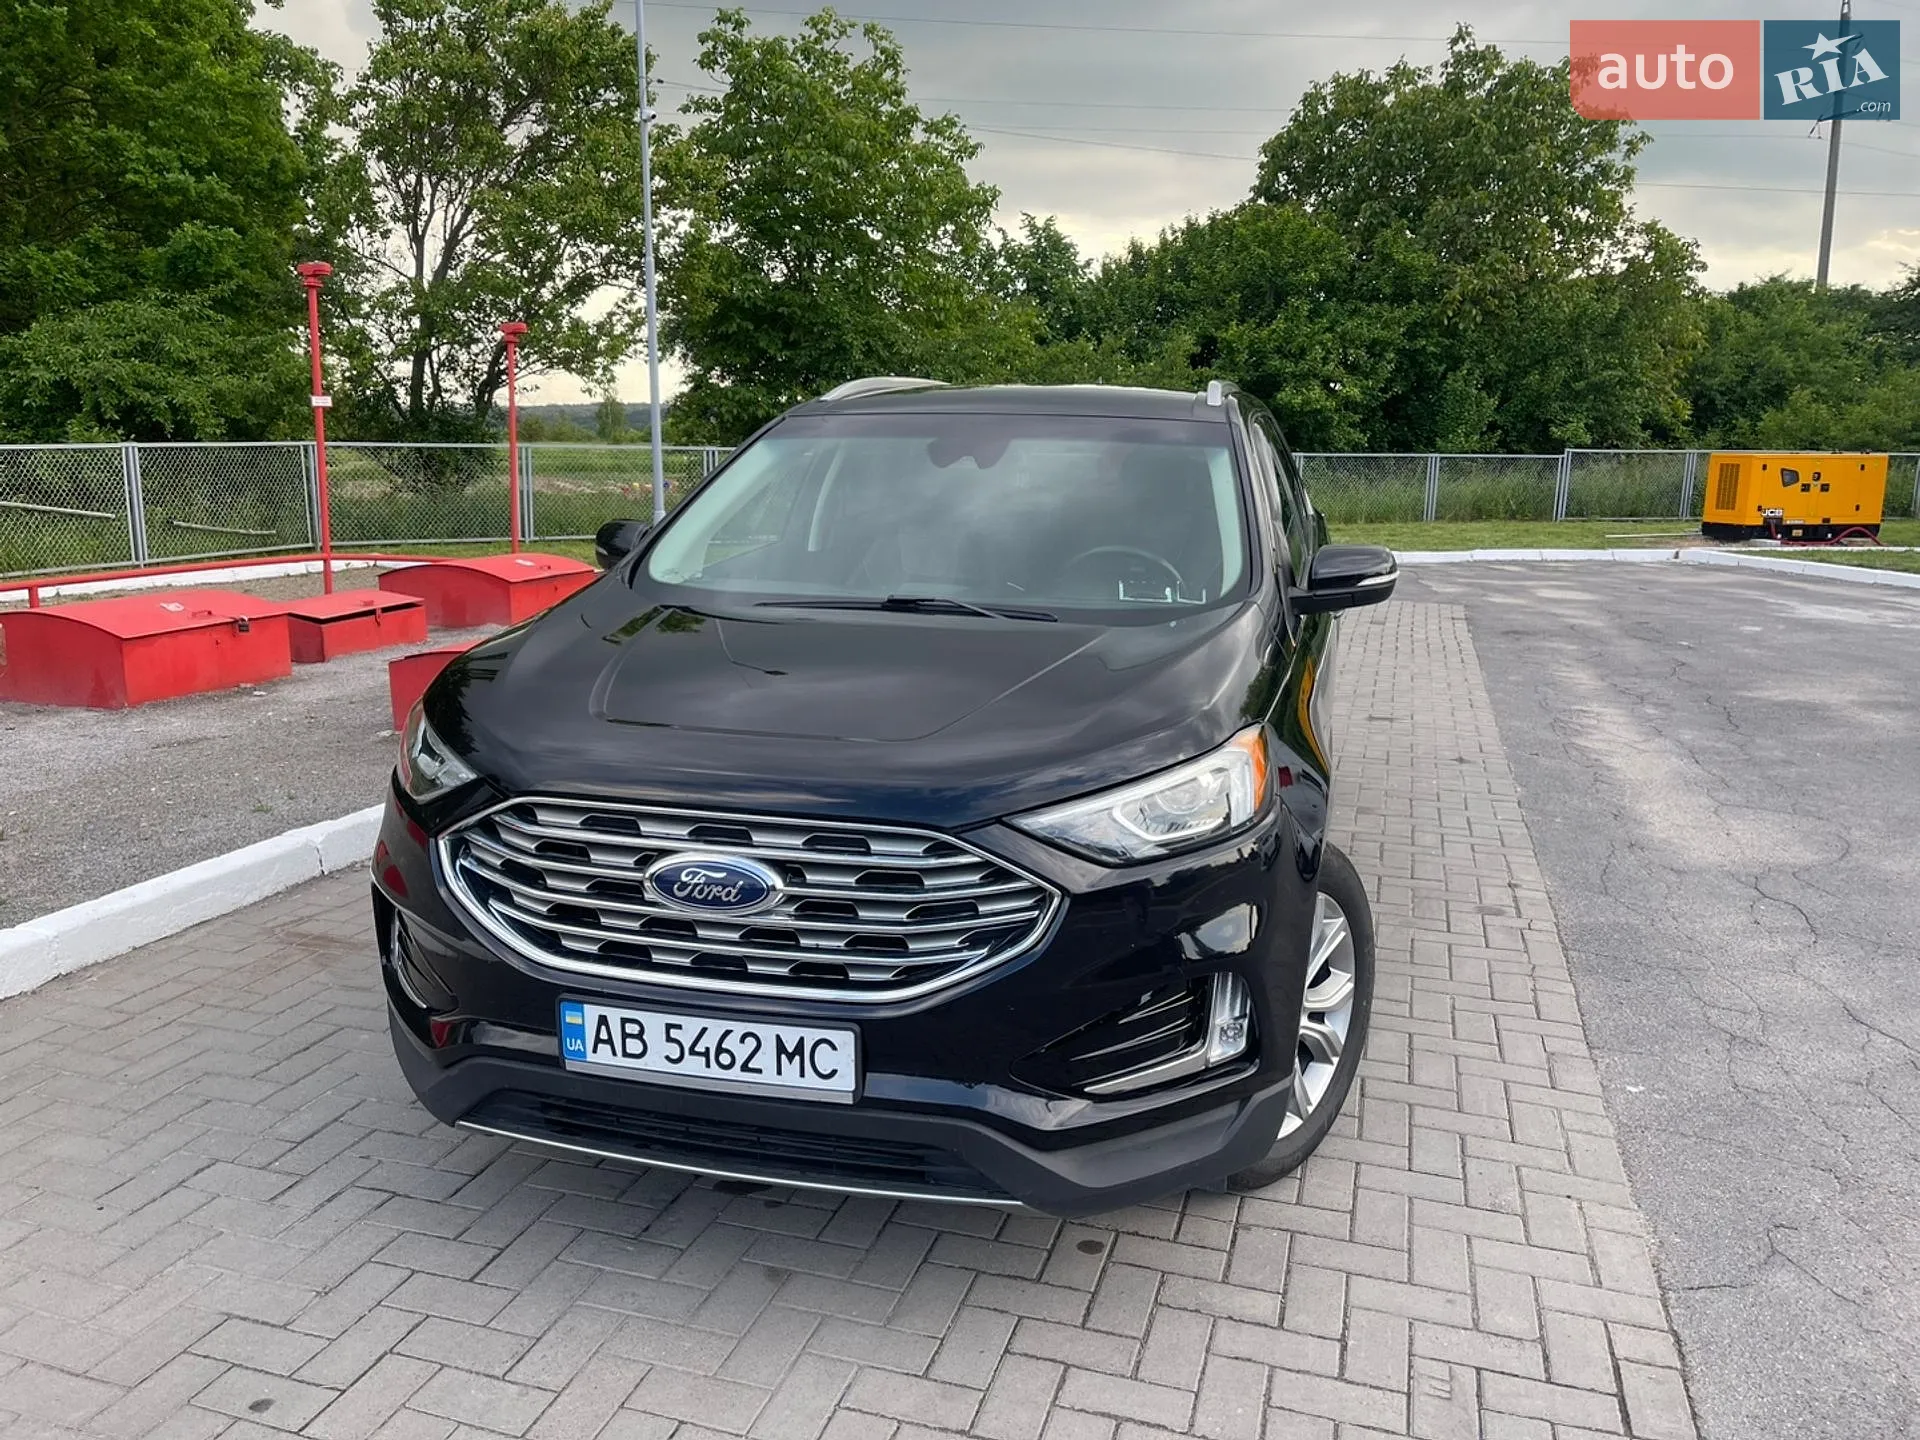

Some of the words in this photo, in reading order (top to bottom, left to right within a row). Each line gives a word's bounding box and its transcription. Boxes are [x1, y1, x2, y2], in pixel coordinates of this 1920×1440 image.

[673, 867, 744, 903] Ford
[566, 1037, 584, 1052] UA
[592, 1014, 649, 1060] AB
[664, 1022, 763, 1075] 5462
[775, 1033, 839, 1080] MC
